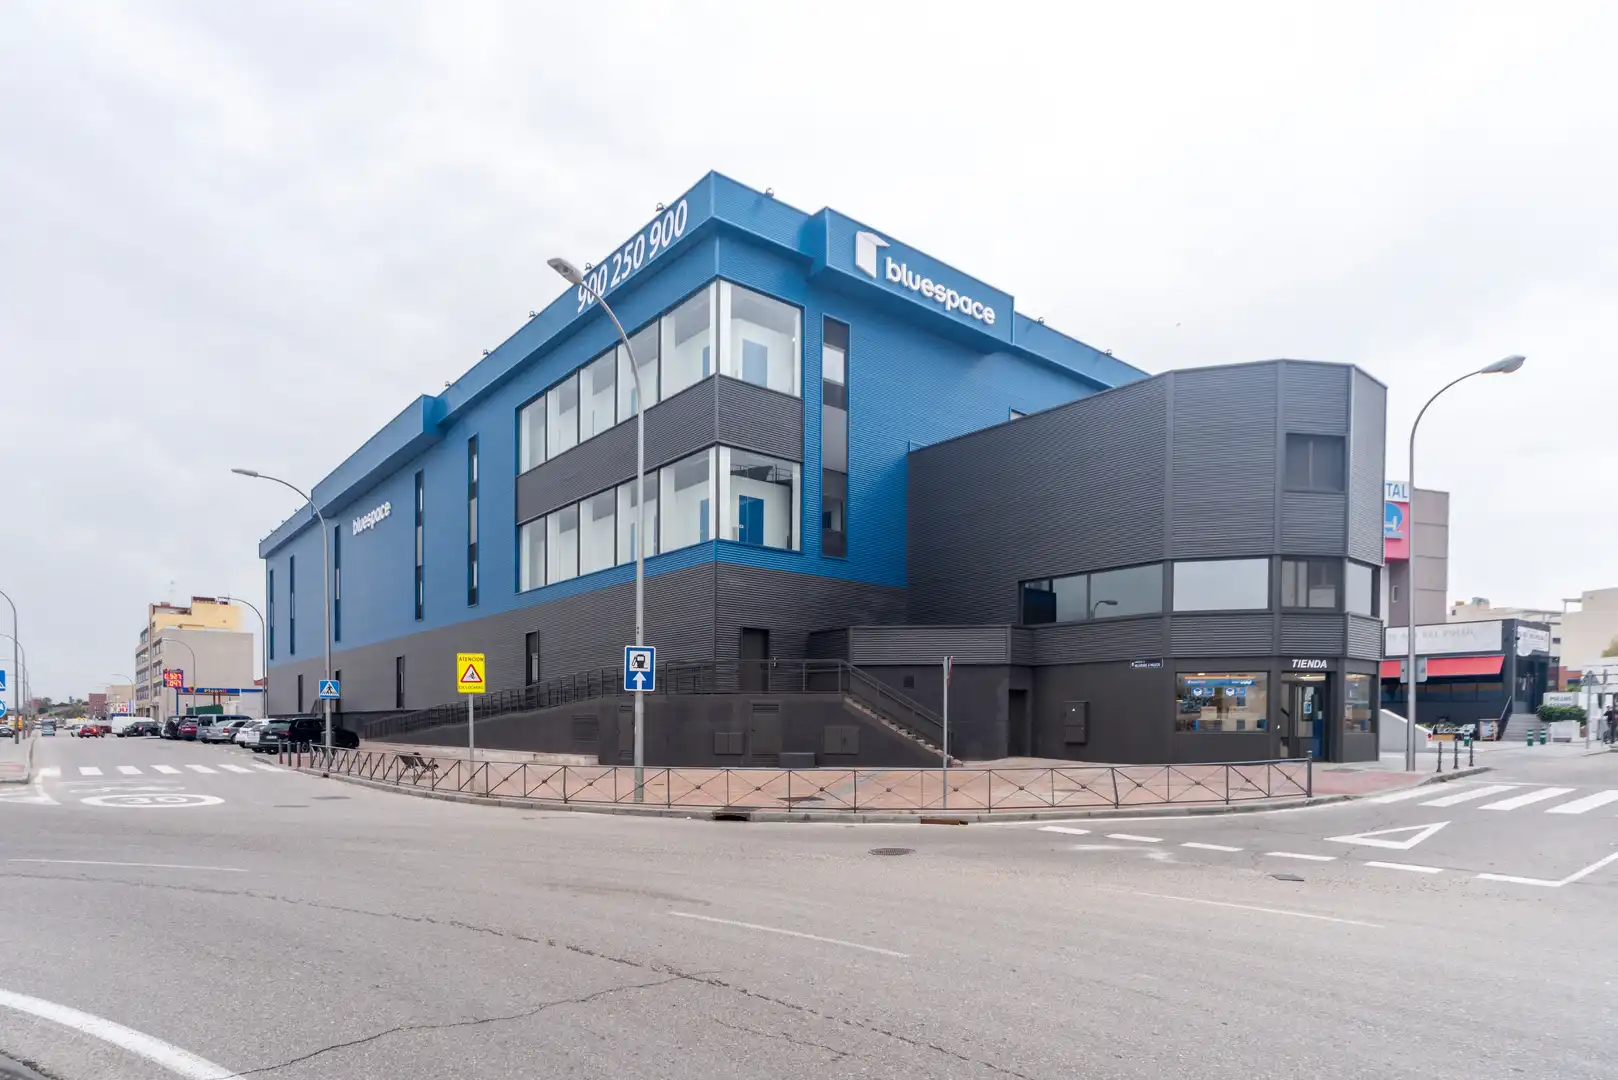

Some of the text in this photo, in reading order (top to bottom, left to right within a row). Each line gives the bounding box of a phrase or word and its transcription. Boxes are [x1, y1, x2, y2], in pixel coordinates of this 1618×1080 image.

[577, 199, 688, 314] 900 250 900
[885, 256, 996, 325] bluespace
[352, 500, 392, 536] bluespace
[1292, 659, 1328, 669] TIENDA
[124, 796, 188, 804] 30
